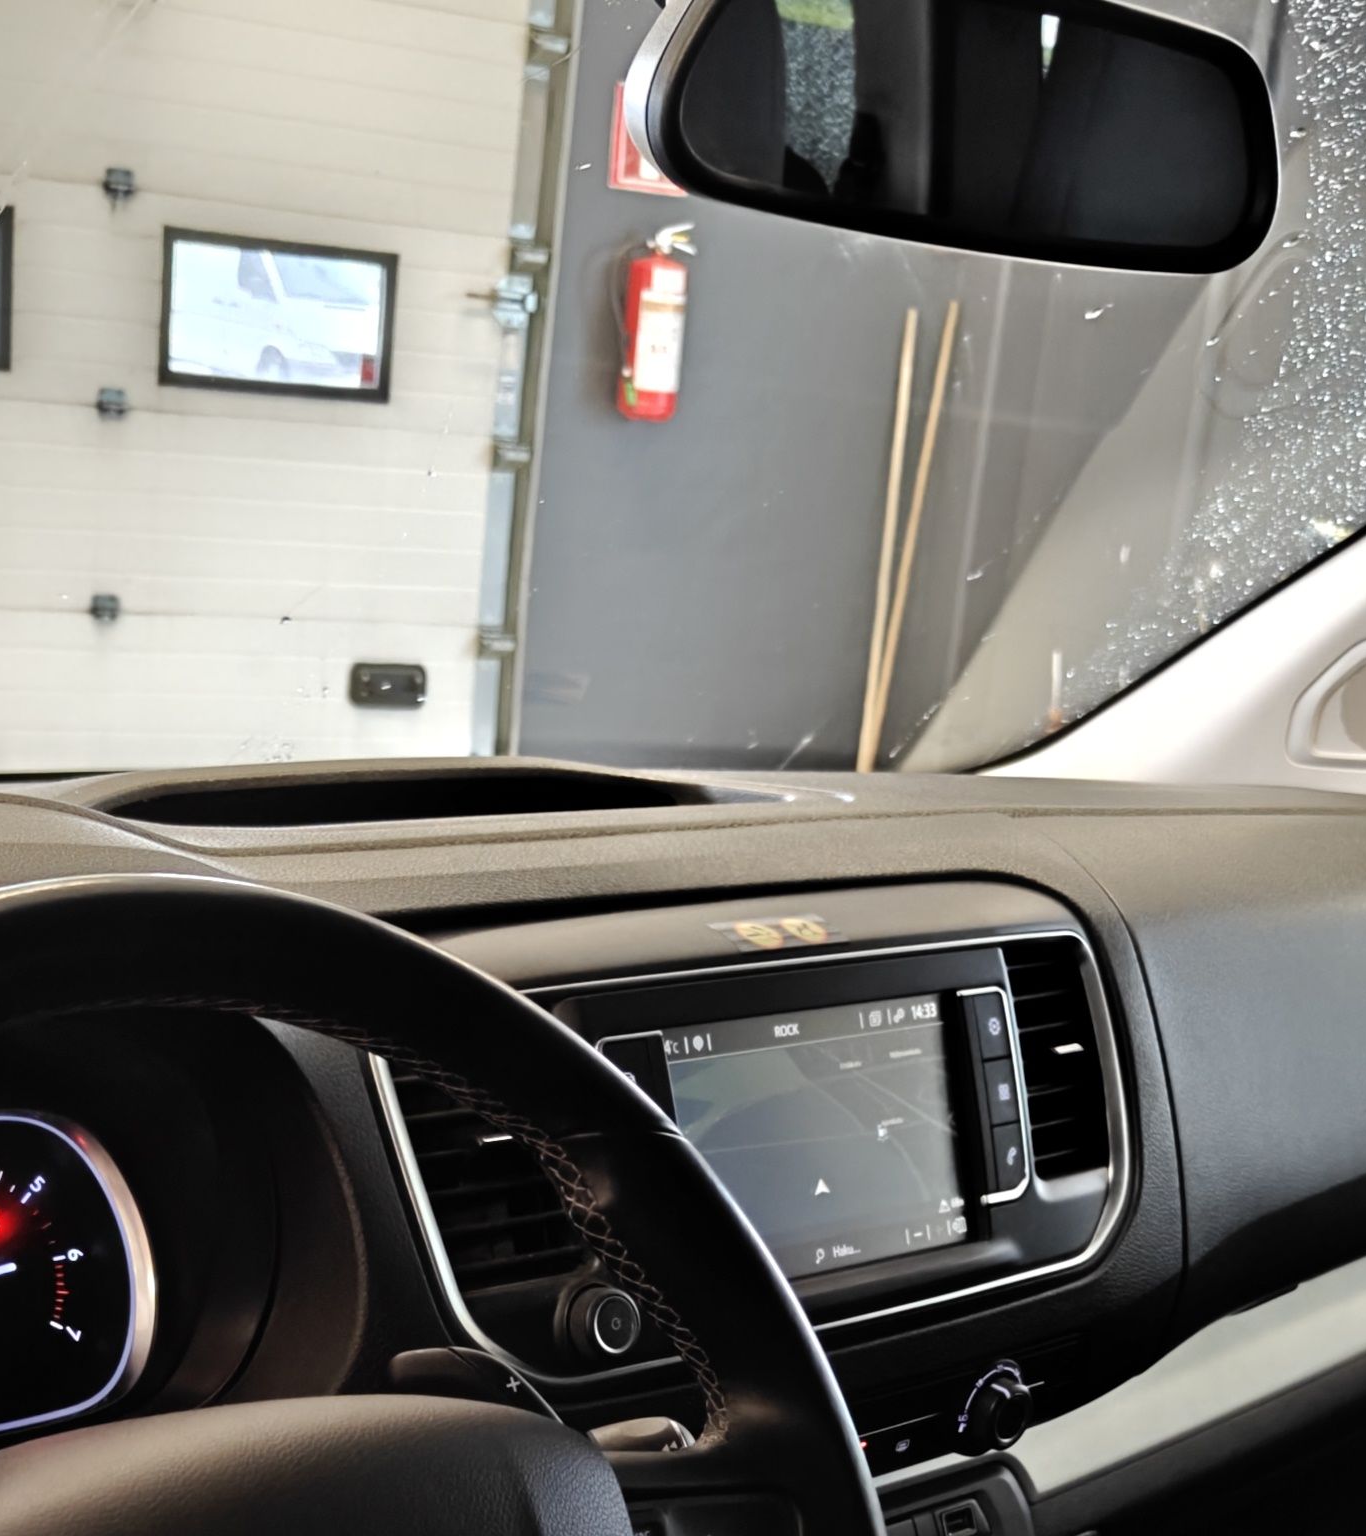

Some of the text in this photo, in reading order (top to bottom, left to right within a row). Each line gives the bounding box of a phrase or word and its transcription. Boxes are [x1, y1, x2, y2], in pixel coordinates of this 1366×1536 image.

[774, 1023, 800, 1037] ROCK
[29, 1175, 46, 1192] 5
[67, 1247, 84, 1262] 6
[66, 1325, 83, 1342] 7
